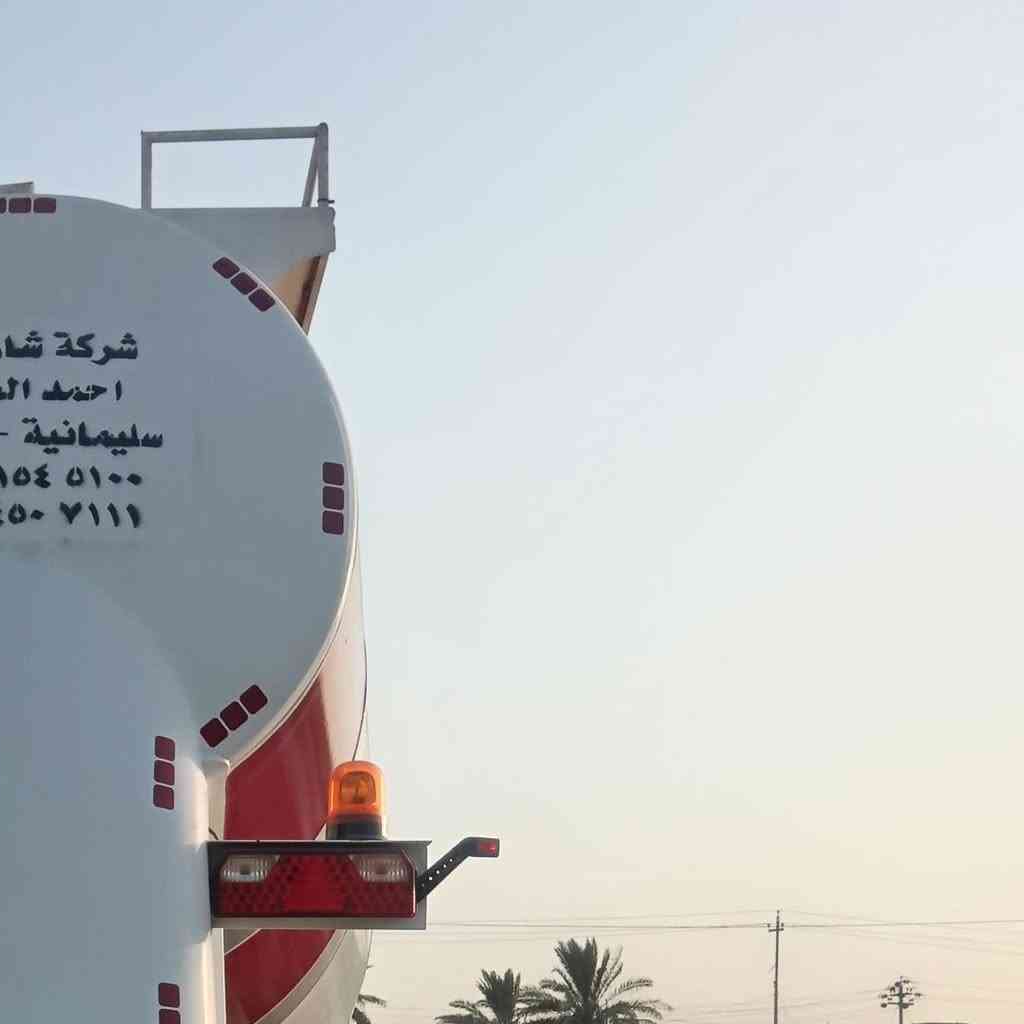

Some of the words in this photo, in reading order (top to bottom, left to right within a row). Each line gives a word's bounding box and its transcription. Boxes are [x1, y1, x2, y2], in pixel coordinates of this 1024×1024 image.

[53, 331, 138, 366] شركة
[42, 379, 123, 402] احمد
[22, 416, 163, 456] سليمانية
[66, 465, 143, 489] ٥١٠٠
[59, 501, 142, 529] ٧١١١
